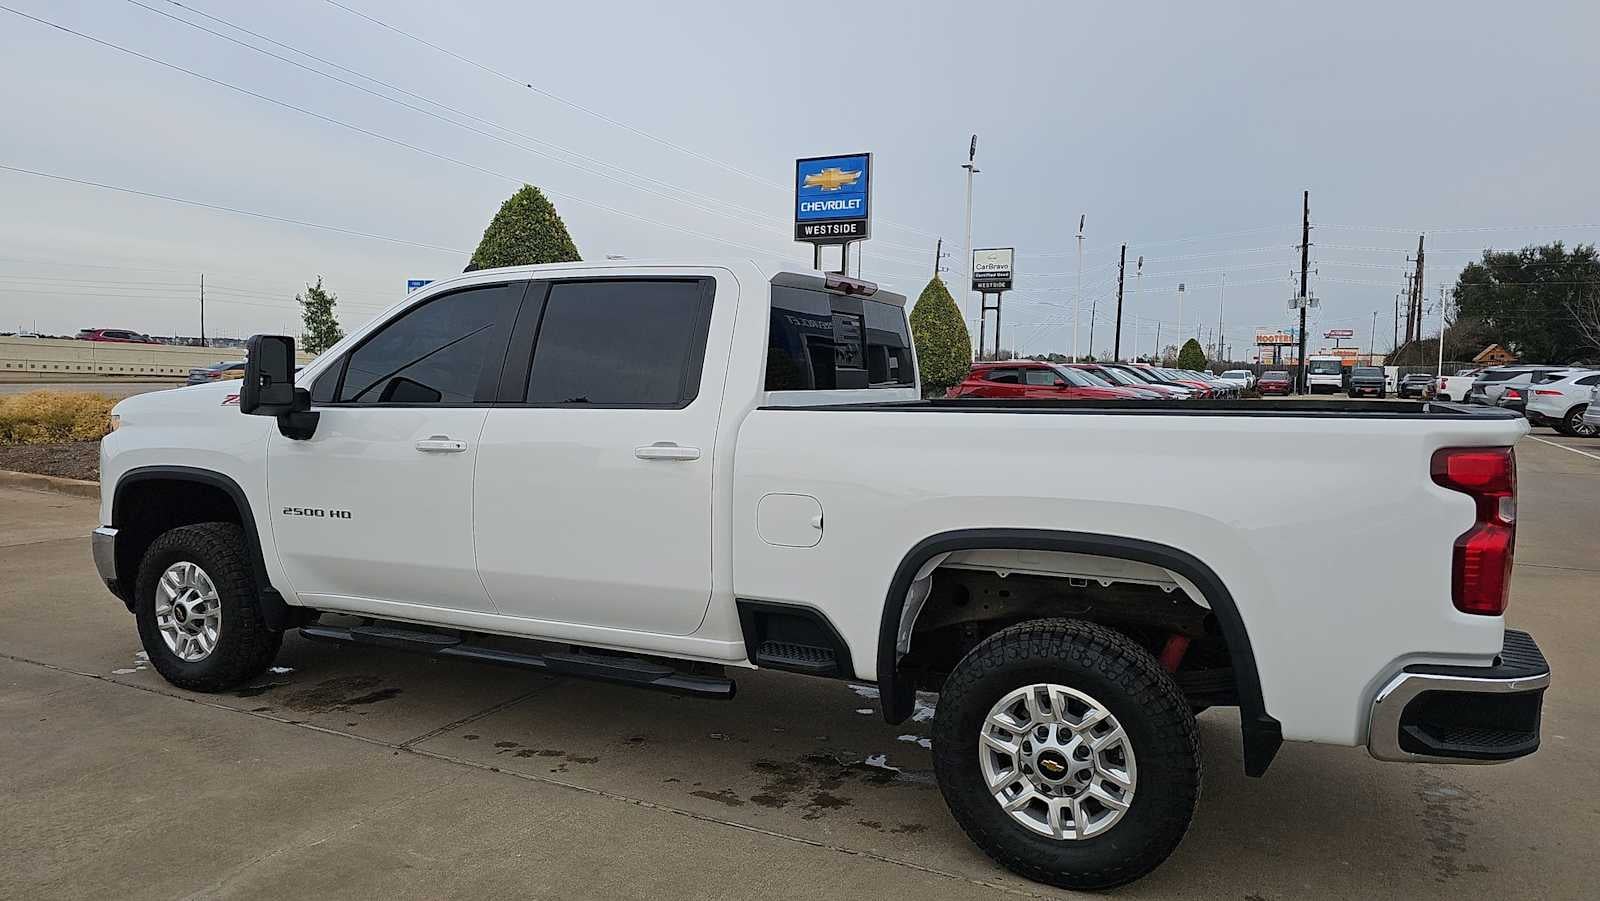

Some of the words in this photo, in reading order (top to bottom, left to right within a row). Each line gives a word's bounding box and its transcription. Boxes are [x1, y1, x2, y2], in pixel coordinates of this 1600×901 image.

[800, 199, 862, 212] CHEVROLET
[804, 223, 857, 235] WESTSIDE
[976, 263, 1009, 271] CarBravo
[283, 507, 325, 517] 2500
[329, 510, 352, 519] HD
